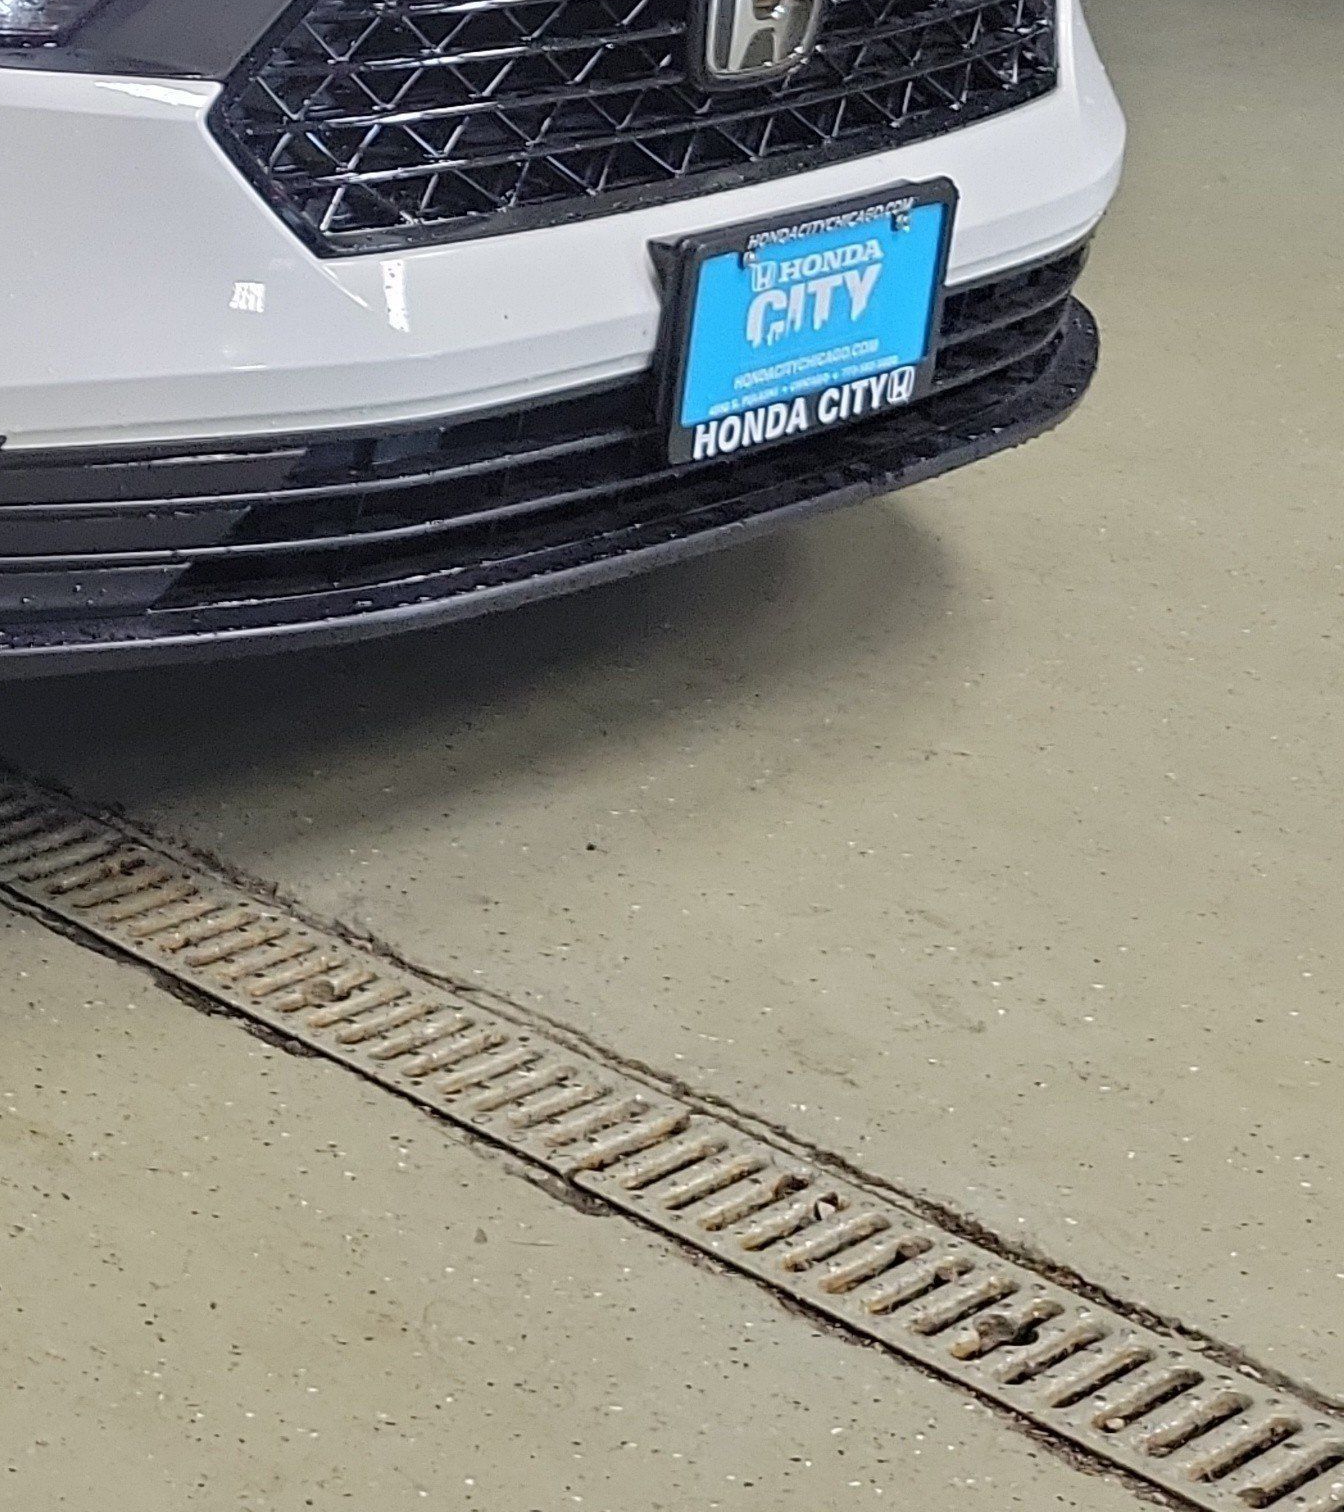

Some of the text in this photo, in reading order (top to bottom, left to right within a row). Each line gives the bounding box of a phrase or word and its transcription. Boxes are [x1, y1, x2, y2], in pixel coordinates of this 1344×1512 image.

[779, 238, 884, 283] HONDA
[746, 263, 883, 348] CITY
[693, 397, 809, 460] HONDA
[818, 373, 889, 425] CITY
